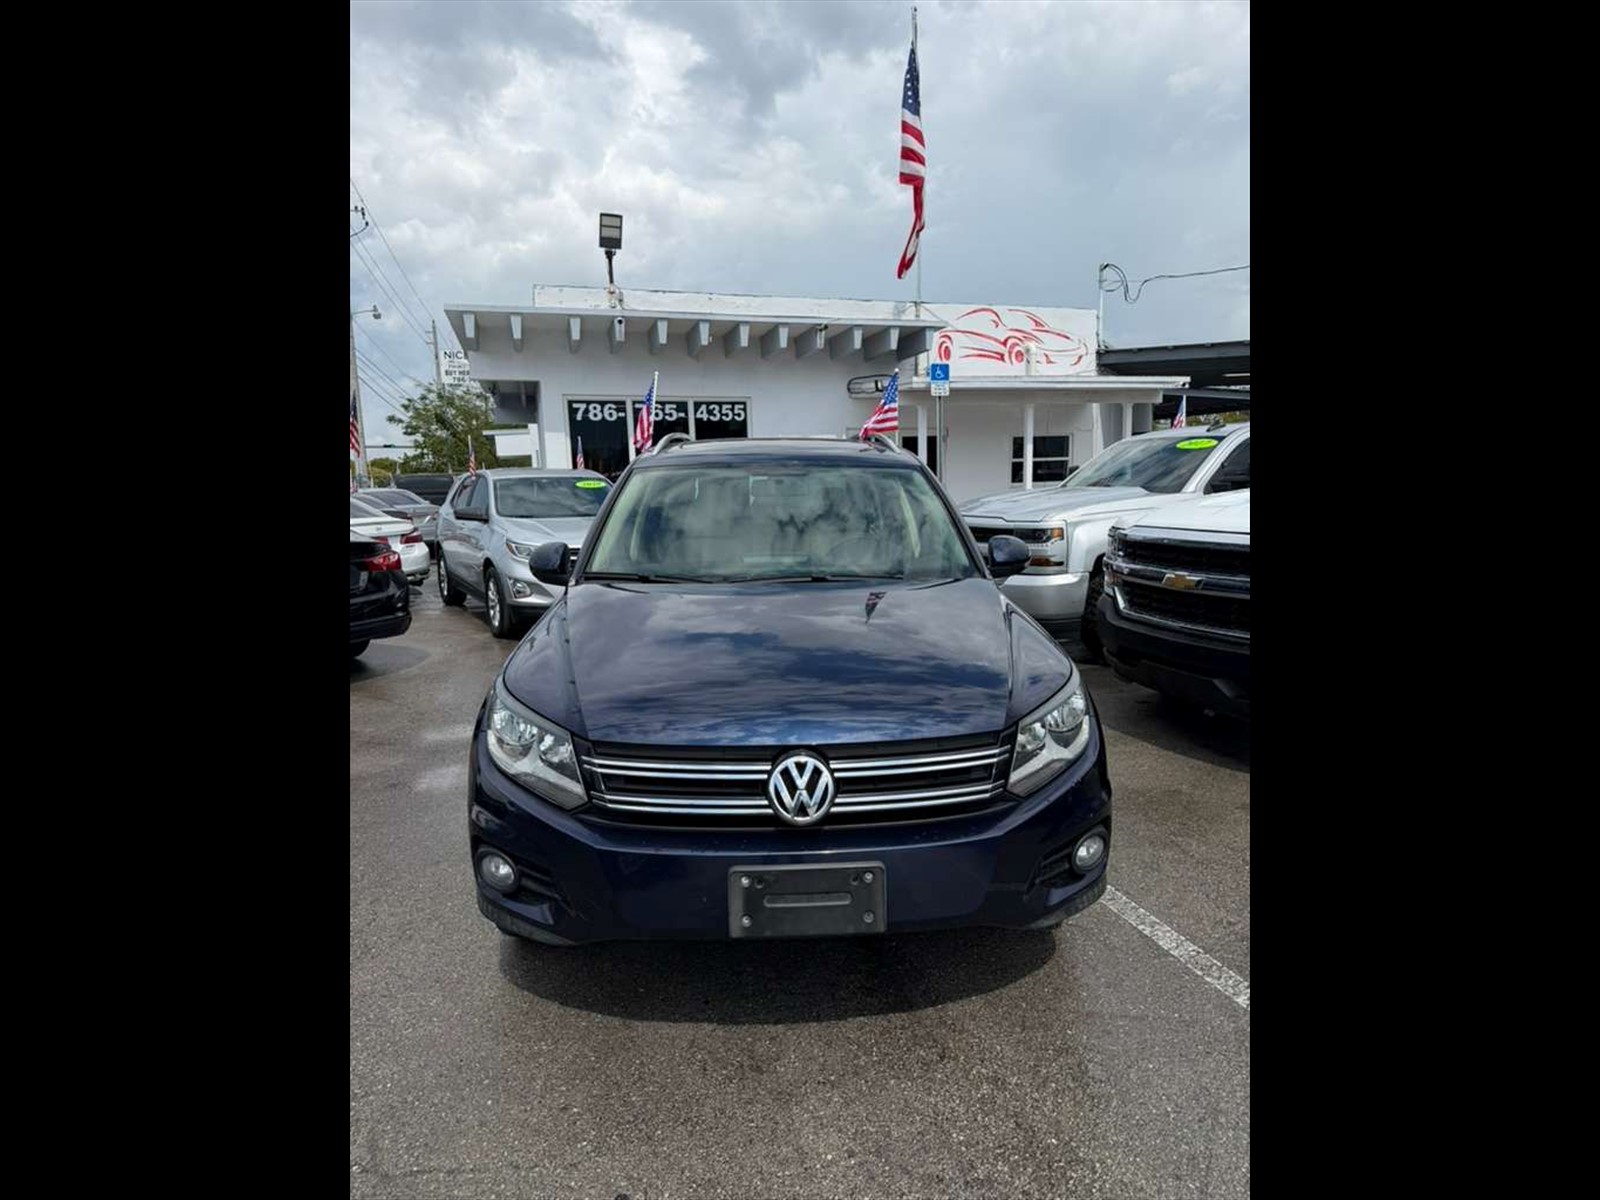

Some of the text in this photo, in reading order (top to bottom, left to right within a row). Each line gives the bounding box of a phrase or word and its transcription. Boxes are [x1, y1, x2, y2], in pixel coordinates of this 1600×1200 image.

[572, 403, 626, 421] 786-
[696, 404, 746, 422] 4355
[769, 756, 834, 820] VW
